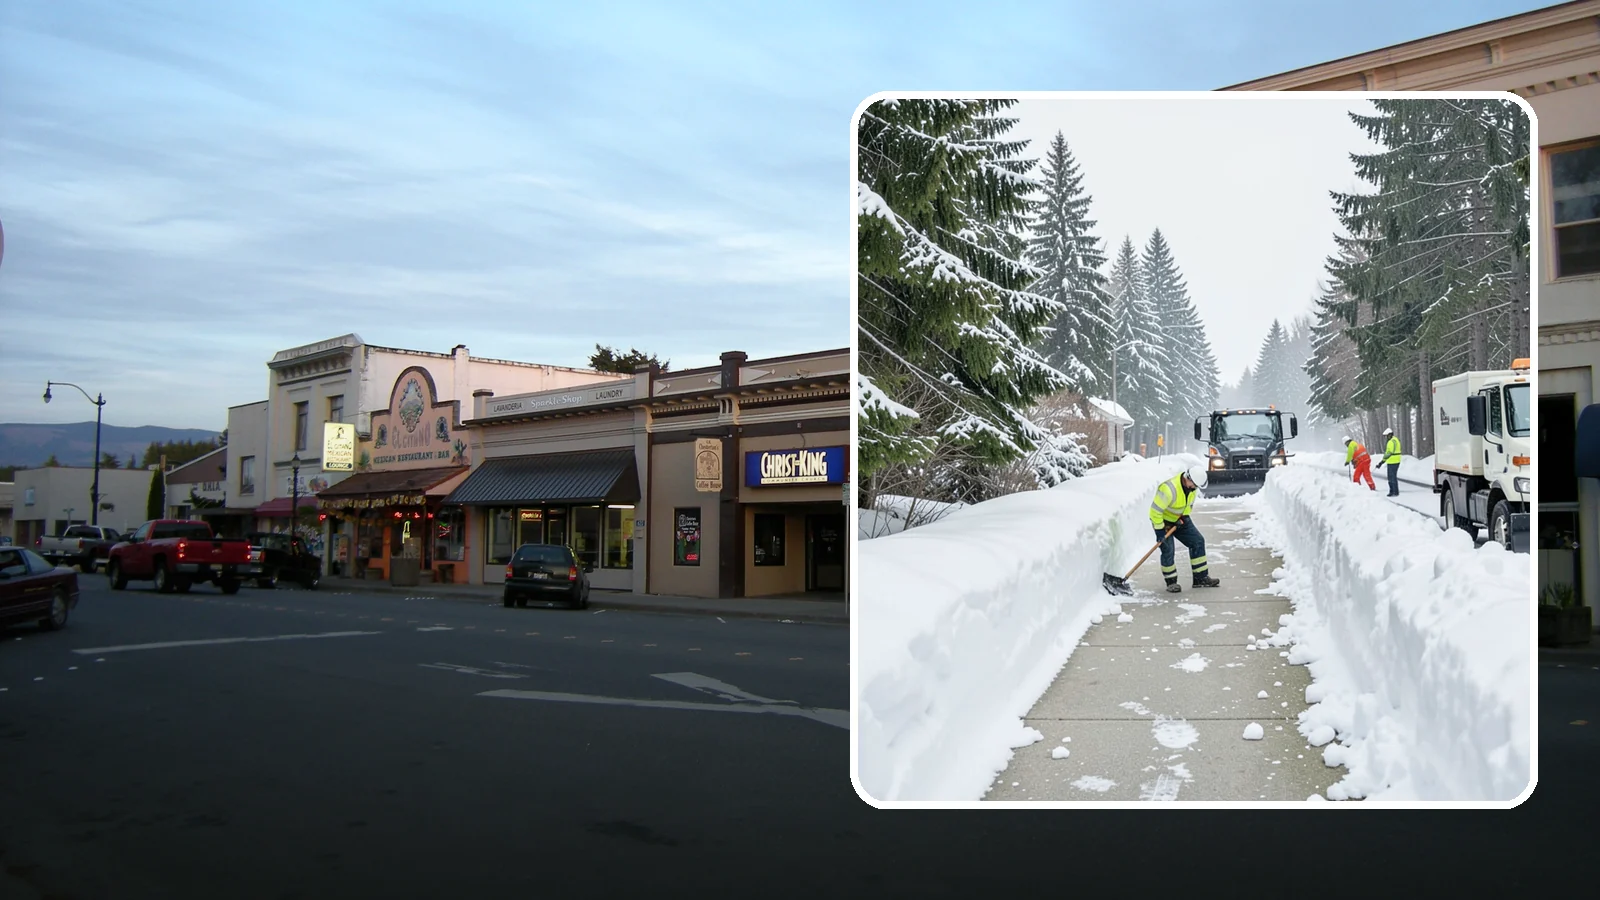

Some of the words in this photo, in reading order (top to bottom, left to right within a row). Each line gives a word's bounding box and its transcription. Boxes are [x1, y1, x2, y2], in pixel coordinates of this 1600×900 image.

[595, 389, 623, 400] LAUNDRY
[493, 402, 522, 412] LAVANDERIA
[531, 399, 560, 409] Sparkle
[562, 394, 582, 405] Shop
[374, 454, 396, 464] MEXICAN
[397, 451, 433, 462] RESTAURANT
[437, 450, 450, 459] BAR
[761, 452, 797, 478] CHRIST
[799, 450, 827, 476] KING
[710, 481, 721, 489] House
